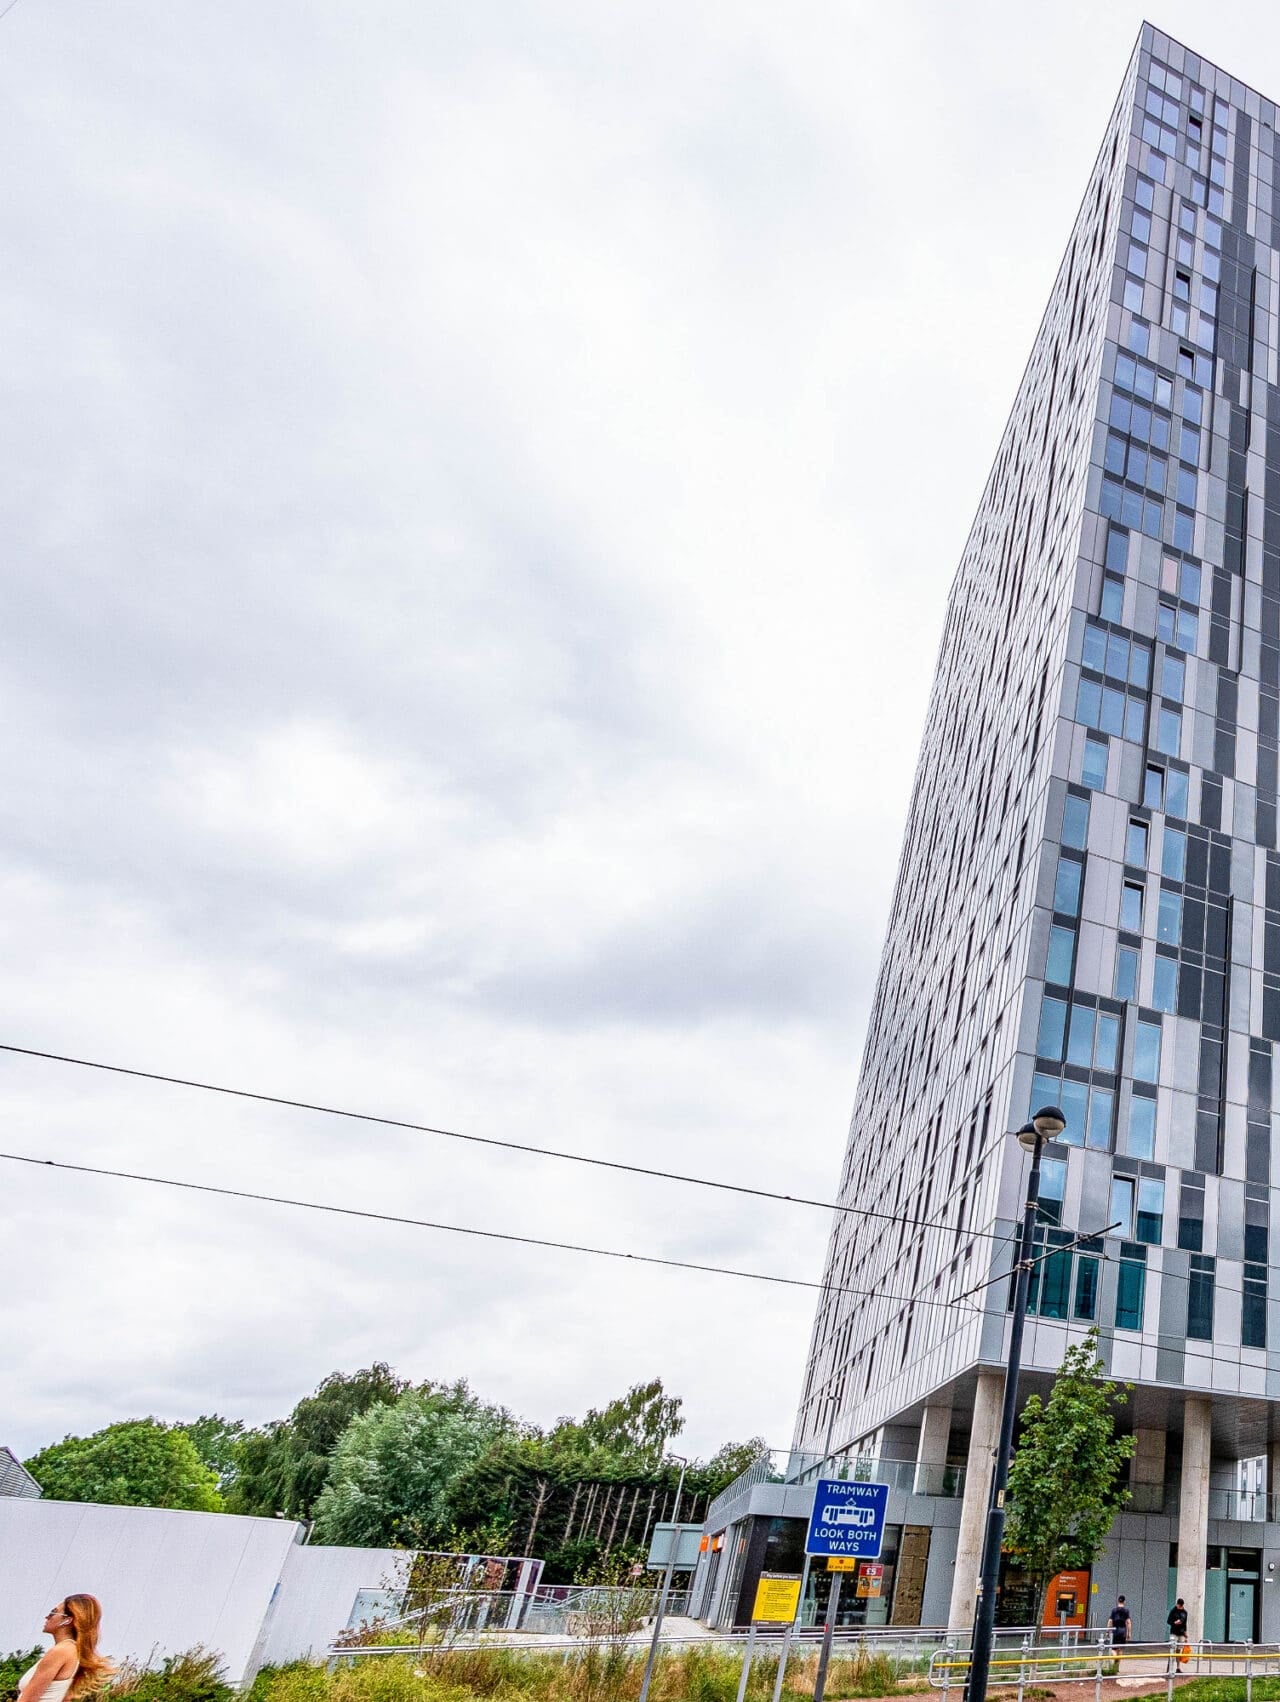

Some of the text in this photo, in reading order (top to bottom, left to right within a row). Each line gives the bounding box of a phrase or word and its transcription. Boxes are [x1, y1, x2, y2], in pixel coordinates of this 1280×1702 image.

[827, 1484, 879, 1498] TRAMWAY
[814, 1528, 877, 1541] LOOK BOTH
[829, 1541, 860, 1552] WAYS
[866, 1567, 877, 1576] £5
